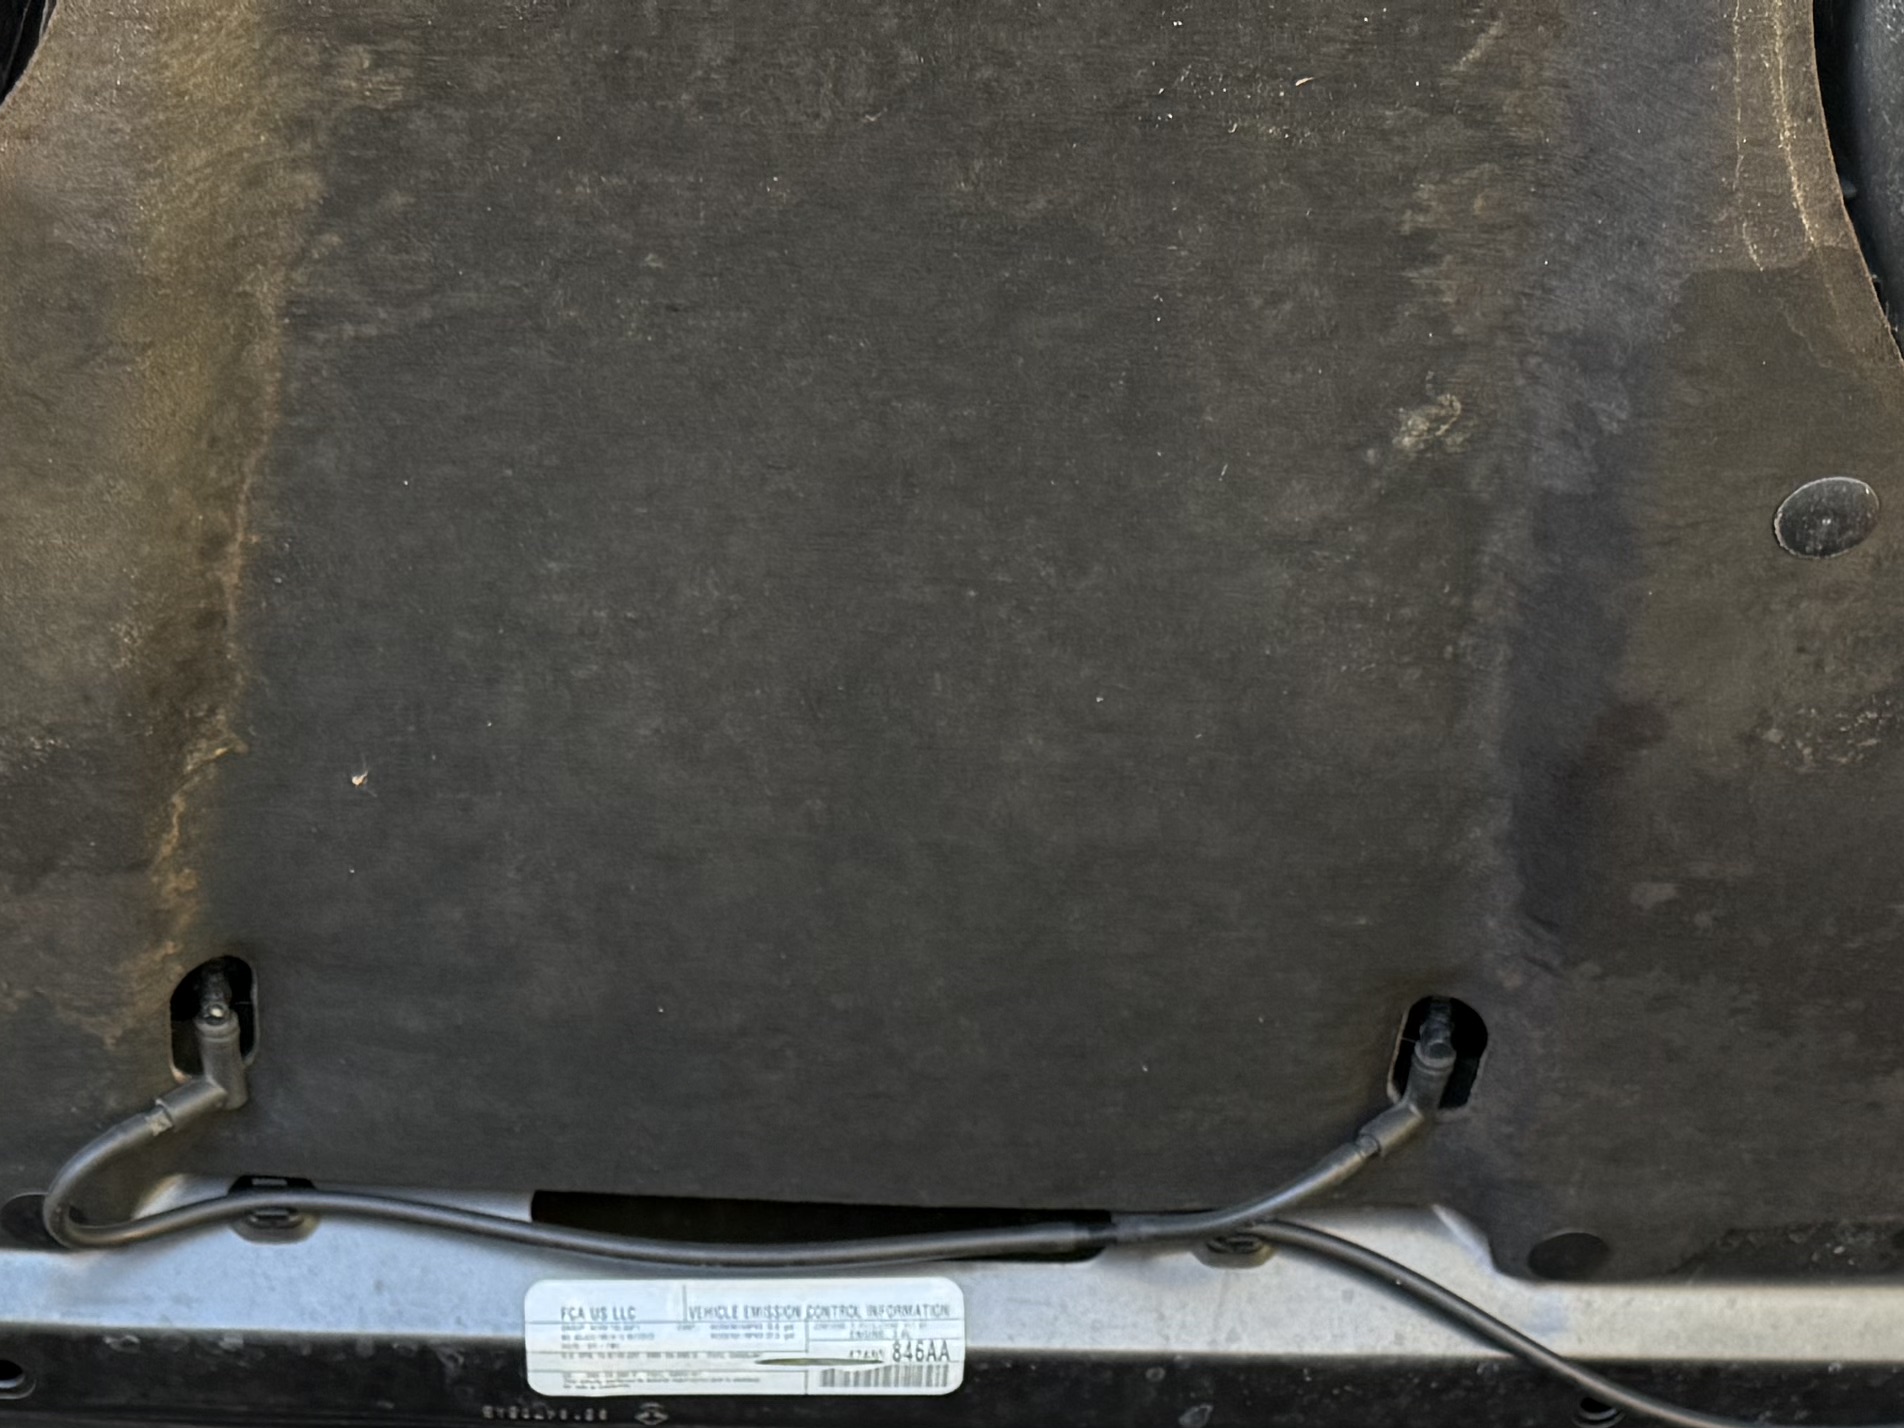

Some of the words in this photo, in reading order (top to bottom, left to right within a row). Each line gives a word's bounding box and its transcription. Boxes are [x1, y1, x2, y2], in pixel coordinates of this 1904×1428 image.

[589, 1305, 608, 1320] US
[612, 1305, 636, 1320] LLC
[688, 1304, 738, 1320] VEHICLE
[743, 1304, 801, 1319] EMISSION
[806, 1304, 861, 1319] CONTROL
[865, 1303, 951, 1318] INFORMATION
[892, 1339, 951, 1363] 846AA
